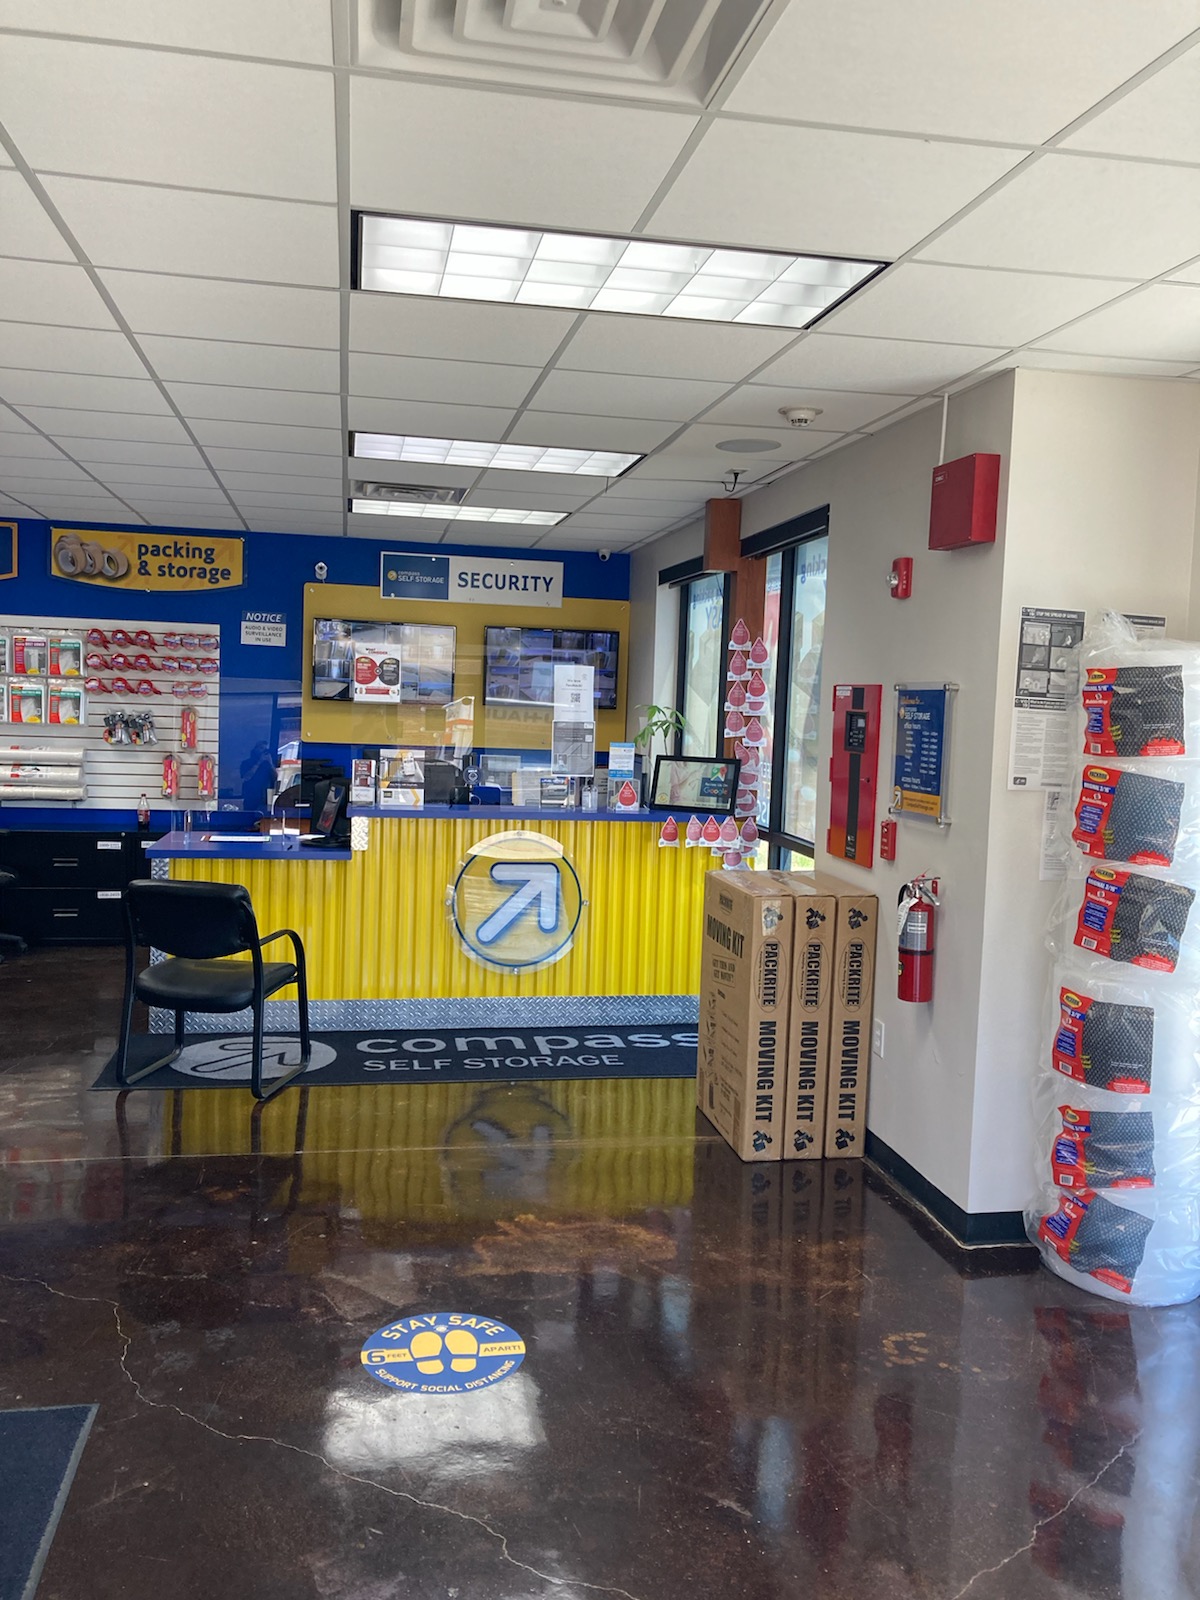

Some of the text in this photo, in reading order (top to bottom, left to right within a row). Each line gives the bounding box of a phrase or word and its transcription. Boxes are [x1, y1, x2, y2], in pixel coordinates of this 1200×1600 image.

[138, 541, 215, 564] packing
[138, 560, 231, 584] & storage
[398, 575, 445, 584] SELF STORAGE
[458, 571, 554, 593] SECURITY
[246, 612, 282, 622] NOTICE
[707, 914, 745, 958] MOVING KIT
[763, 943, 778, 1005] PACKRITE
[805, 944, 821, 1006] PACKRITE
[847, 944, 863, 1005] PACKRITE
[356, 1032, 698, 1055] compass
[363, 1054, 624, 1071] SELF STORAGE
[755, 1021, 776, 1122] MOVING KIT
[797, 1021, 818, 1122] MOVING KIT
[838, 1021, 860, 1121] MOVING KIT
[381, 1315, 505, 1340] STAY SAFE
[366, 1349, 387, 1365] 6
[375, 1359, 515, 1392] SUPPORT SOCIAL DISTANCING
